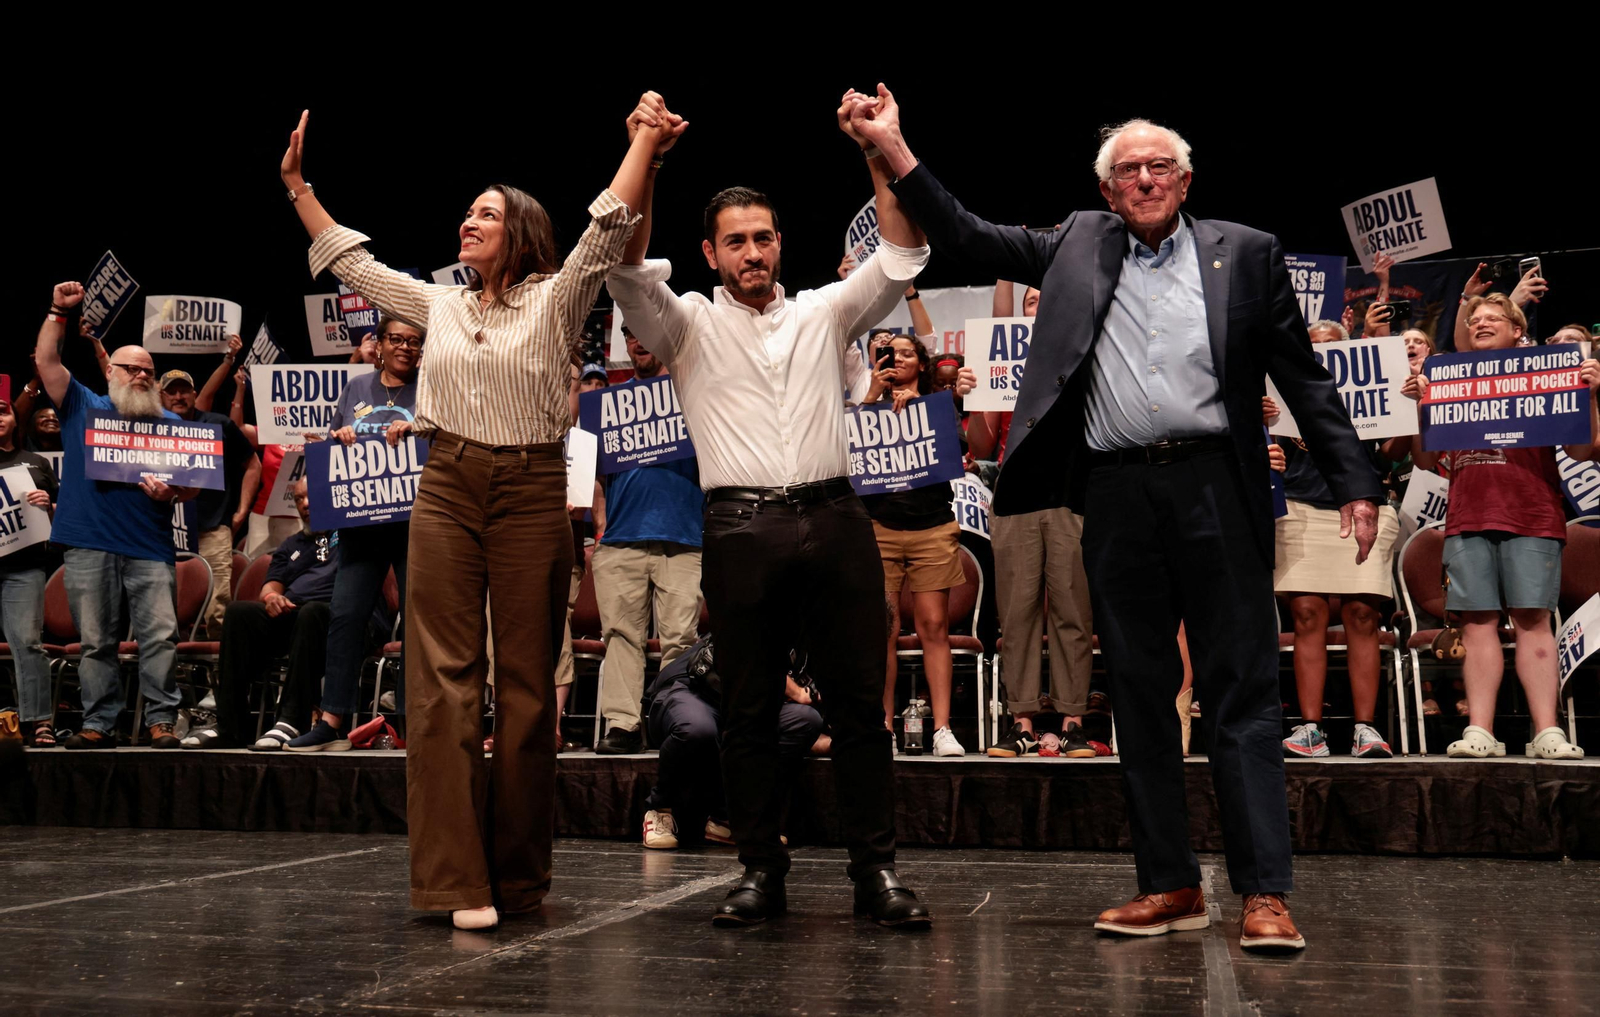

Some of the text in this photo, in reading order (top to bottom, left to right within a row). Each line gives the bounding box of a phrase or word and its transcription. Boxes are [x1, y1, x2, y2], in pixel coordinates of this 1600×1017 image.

[849, 201, 878, 248] ABD
[1352, 189, 1422, 236] ABDUL
[1368, 219, 1427, 254] SENATE
[83, 259, 119, 312] DICARE
[102, 272, 132, 307] ALL
[161, 331, 173, 339] US
[175, 324, 227, 341] SENATE
[326, 332, 338, 341] US
[990, 366, 1008, 377] FOR
[1431, 351, 1580, 381] MONEY OUT OF POLITICS
[990, 375, 1008, 389] US
[1430, 370, 1580, 400] MONEY IN YOUR POCKET
[273, 405, 338, 428] FOR US SENA
[1430, 391, 1580, 425] MEDICARE FOR ALL
[94, 418, 215, 439] MONEY OUT OF POLITICS
[603, 415, 688, 454] FOR US SENATE
[844, 401, 936, 449] ABDUL
[93, 432, 215, 453] MONEY IN YOUR POCKET
[616, 446, 678, 463] AbdulForSenate.com
[93, 447, 216, 469] MEDICARE FOR ALL
[329, 436, 424, 482] ABDUL
[850, 452, 864, 463] OR
[866, 438, 939, 475] SENATE
[331, 484, 349, 498] FOR
[861, 471, 929, 486] AbdulForSenate.com
[332, 493, 350, 508] US
